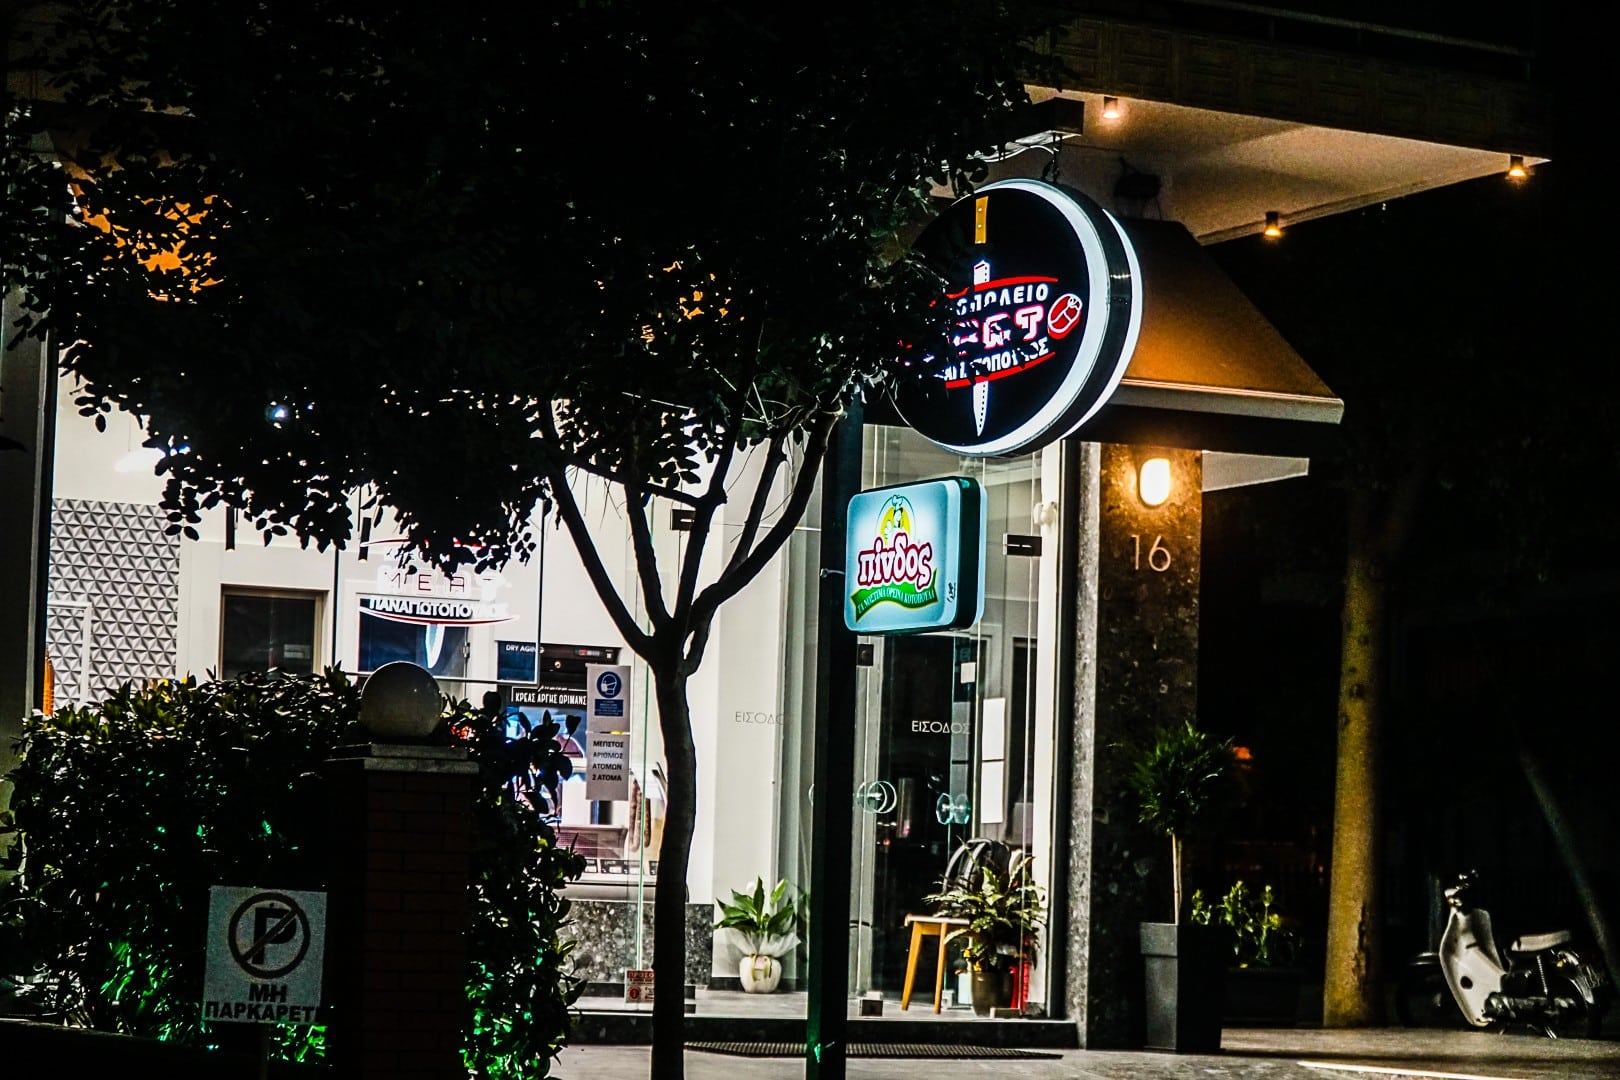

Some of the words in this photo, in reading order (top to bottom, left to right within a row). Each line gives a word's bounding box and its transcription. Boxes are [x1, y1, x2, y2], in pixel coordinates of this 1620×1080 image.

[1130, 533, 1171, 572] 16
[558, 694, 587, 706] ΩΡΙΜΑΝΣ
[735, 711, 785, 725] ΕΙΣΟΔΟ
[911, 720, 971, 735] ΕΙΣΟΔΟΣ
[592, 763, 622, 771] ΑΤΟΜΩΝ
[249, 982, 288, 1003] ΜΗ
